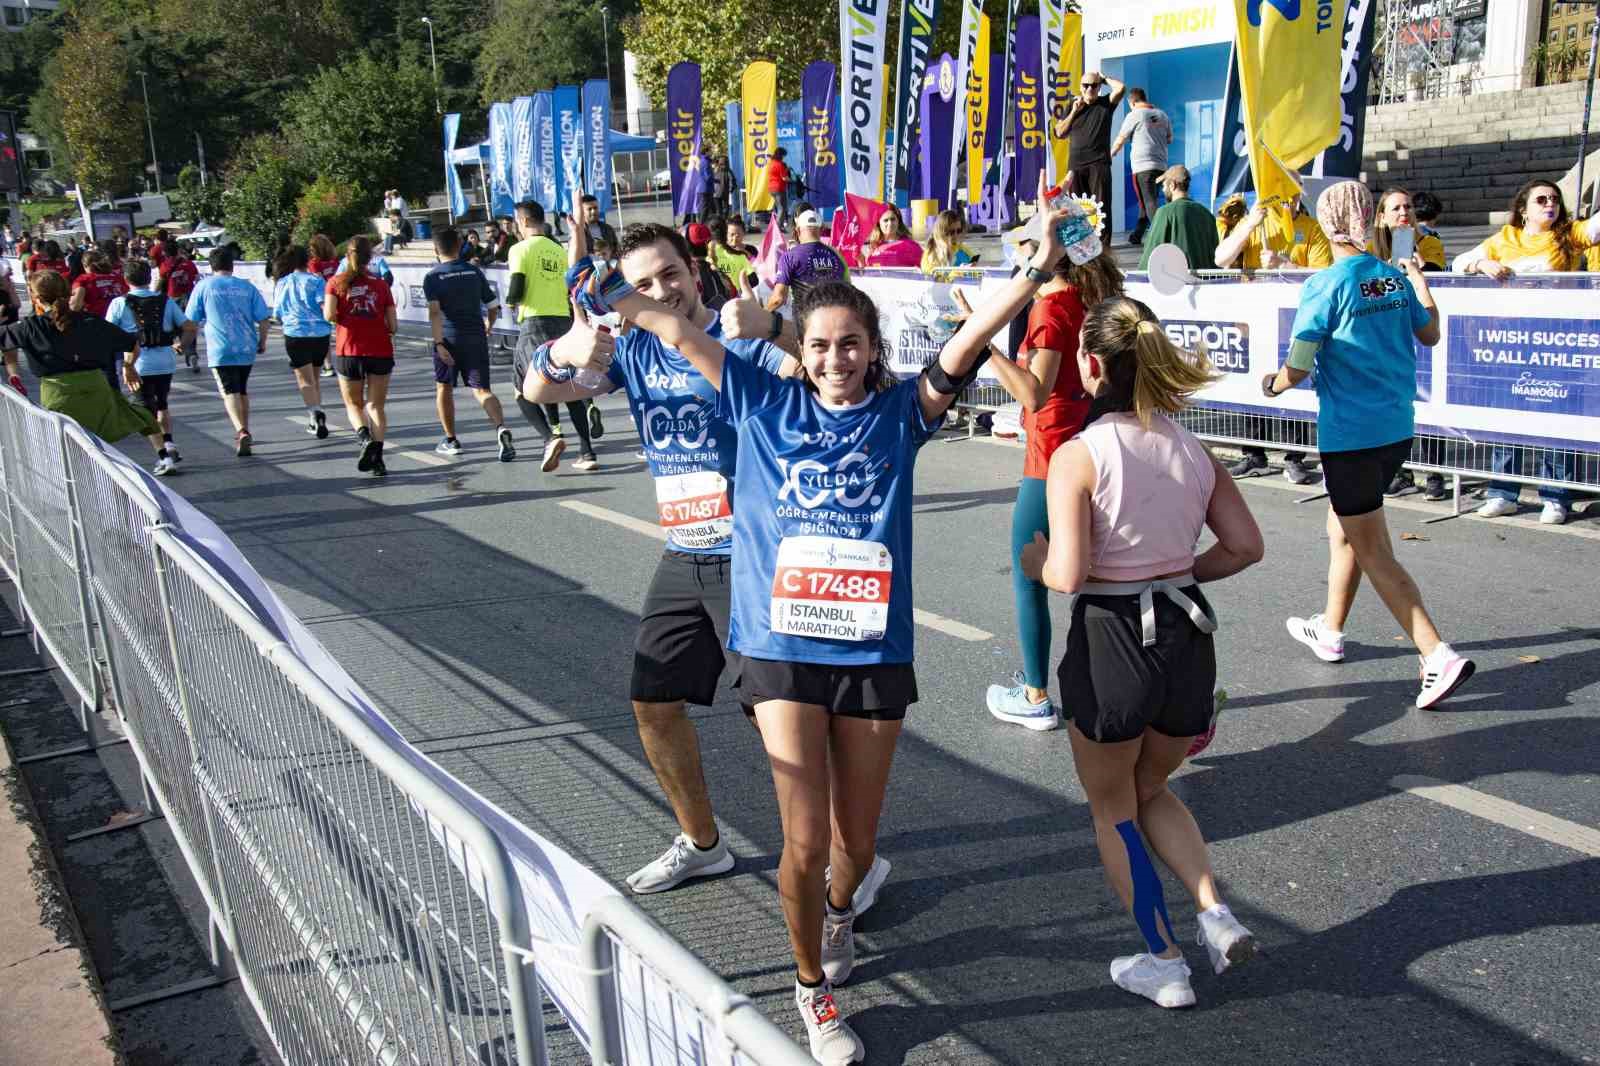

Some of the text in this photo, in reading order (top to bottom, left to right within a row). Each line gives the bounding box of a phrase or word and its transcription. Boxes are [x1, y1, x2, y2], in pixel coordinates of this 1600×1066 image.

[1151, 7, 1217, 37] FINISH
[968, 75, 985, 149] getir
[1015, 71, 1045, 149] getir
[591, 105, 607, 190] DECATHLON
[672, 107, 700, 171] getir
[748, 107, 772, 168] getir
[807, 106, 836, 167] getir
[1478, 329, 1600, 347] I WISH SUCCES
[1473, 349, 1600, 369] TO ALL ATHLETE
[656, 419, 695, 432] YILDA
[804, 471, 860, 488] YILDA
[662, 496, 722, 521] C 17487
[782, 569, 880, 600] C 17488
[790, 604, 856, 622] ISTANBUL
[787, 621, 856, 637] MARATHON
